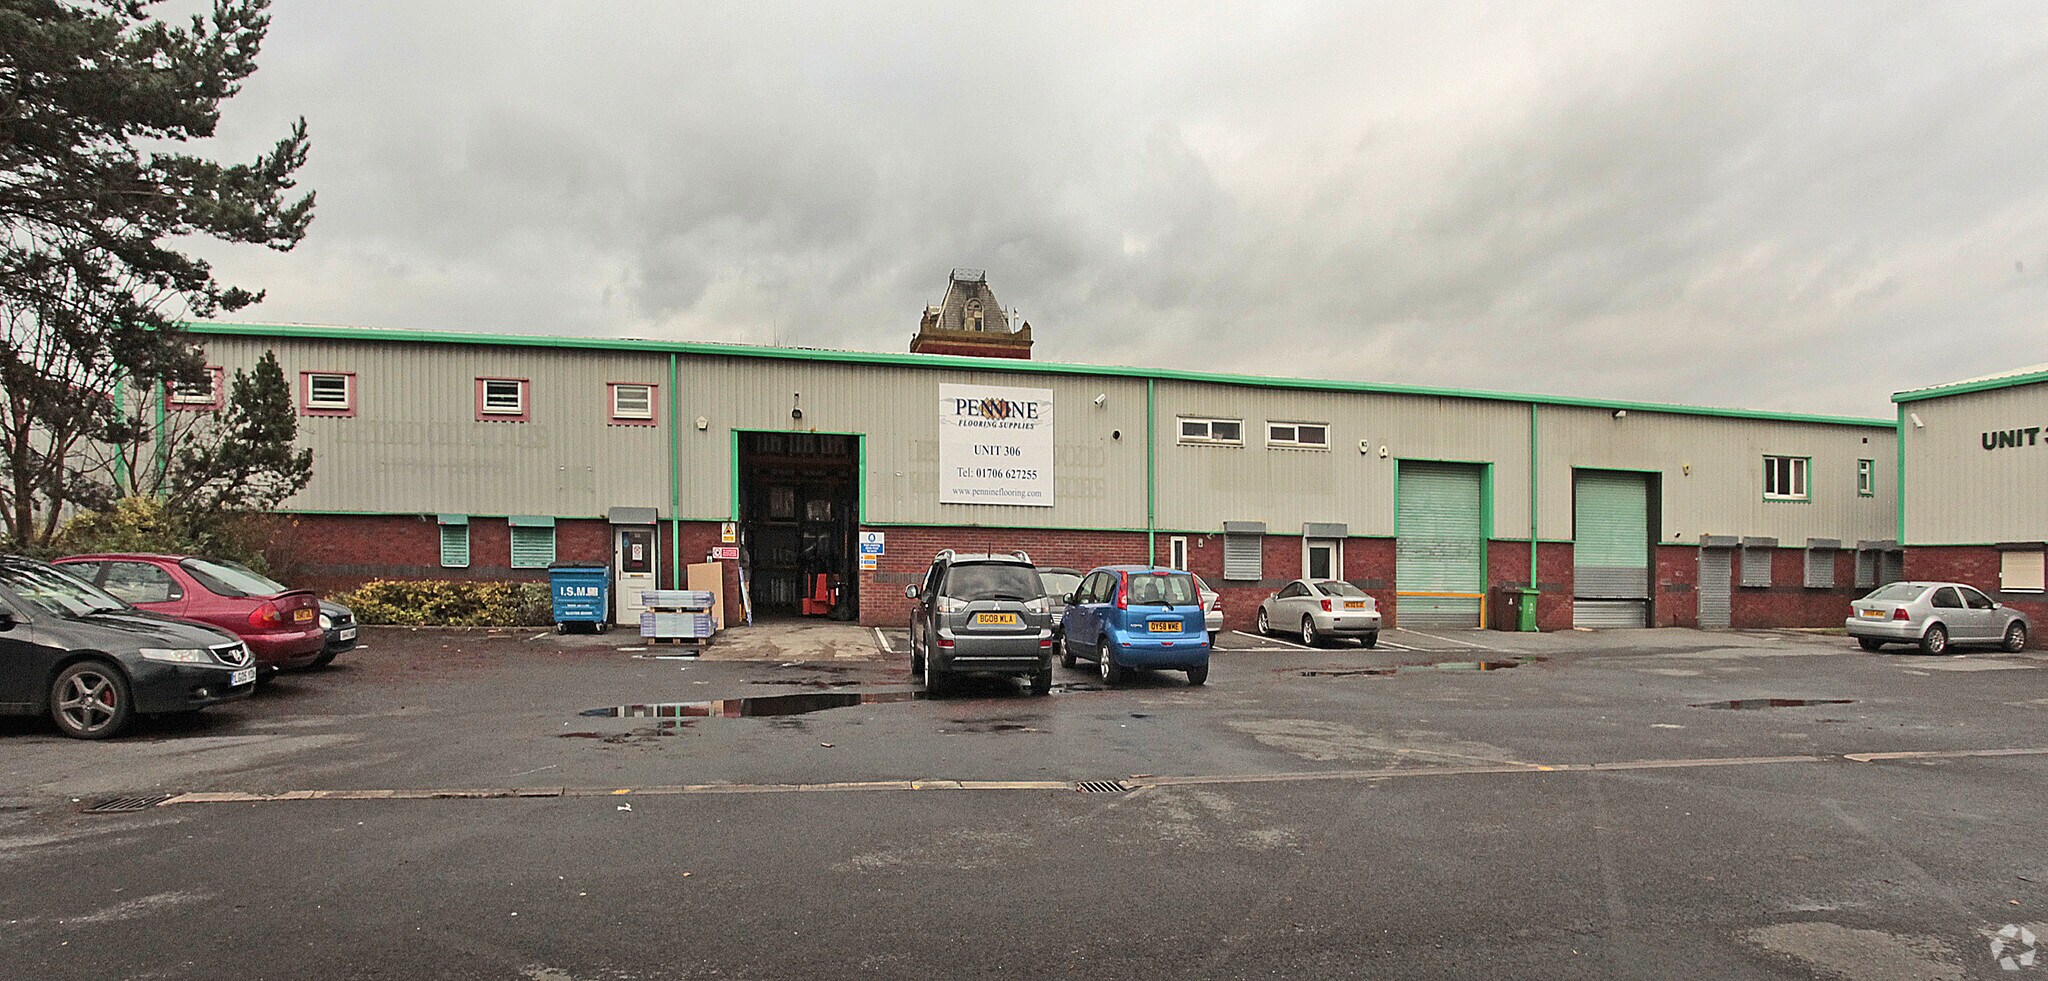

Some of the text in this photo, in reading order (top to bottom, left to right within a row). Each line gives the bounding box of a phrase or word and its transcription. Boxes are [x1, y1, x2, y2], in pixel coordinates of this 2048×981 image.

[955, 398, 1038, 420] PENNINE
[958, 420, 1035, 430] FLOORING SUPPLIES
[1982, 427, 2040, 451] UNIT
[974, 444, 1021, 457] UNIT 306
[957, 467, 1038, 480] Tel: 01706 627255
[952, 487, 1042, 499] www.pennineflooring.com
